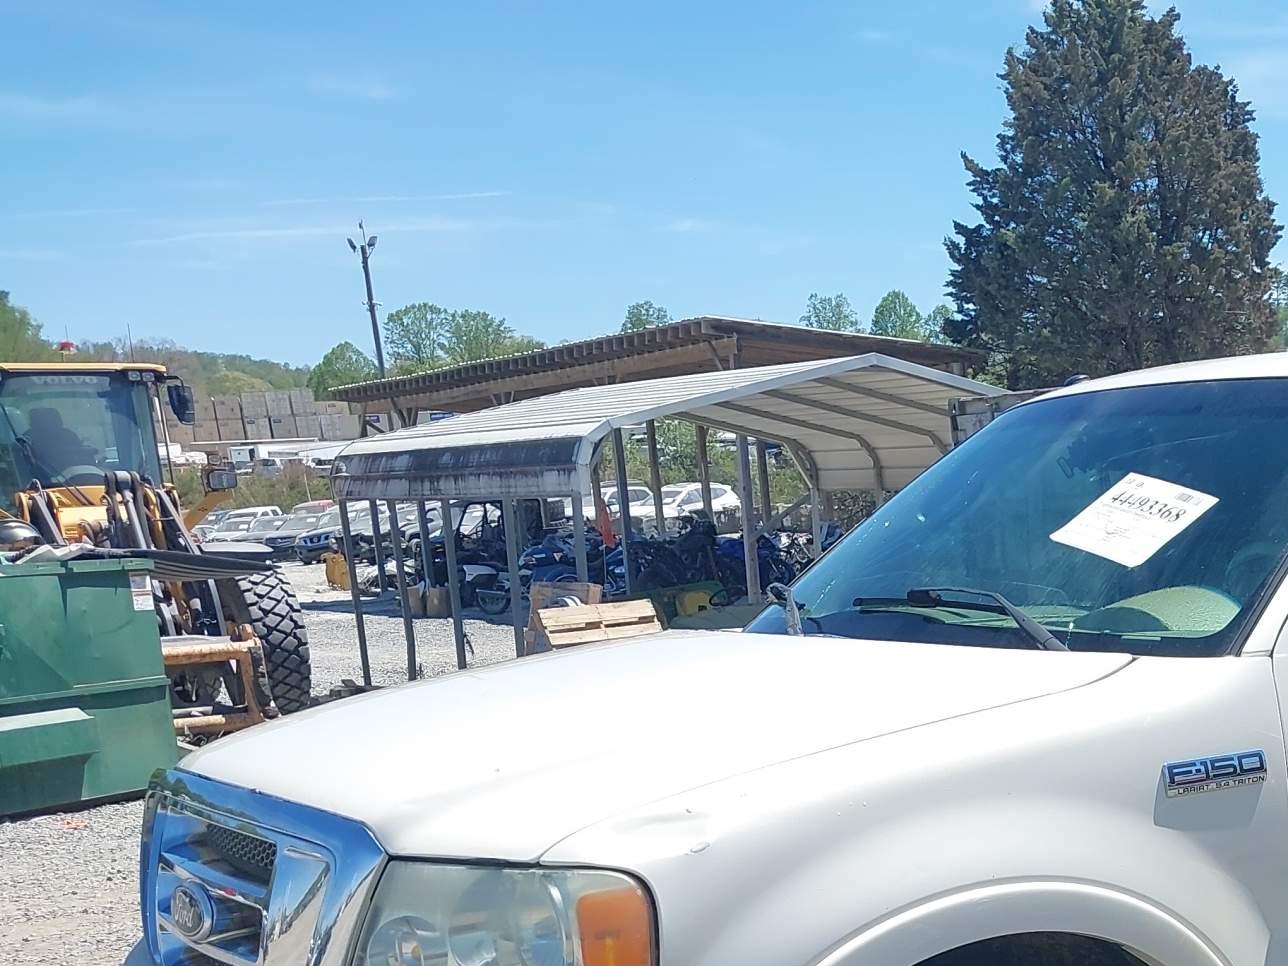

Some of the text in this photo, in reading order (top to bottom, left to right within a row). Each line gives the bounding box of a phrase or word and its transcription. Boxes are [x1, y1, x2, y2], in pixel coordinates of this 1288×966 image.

[31, 376, 98, 385] VOLVO
[1111, 491, 1187, 523] 44493368
[1166, 750, 1267, 787] F-150
[1177, 784, 1210, 795] LARIAT
[1233, 775, 1266, 787] TRITON
